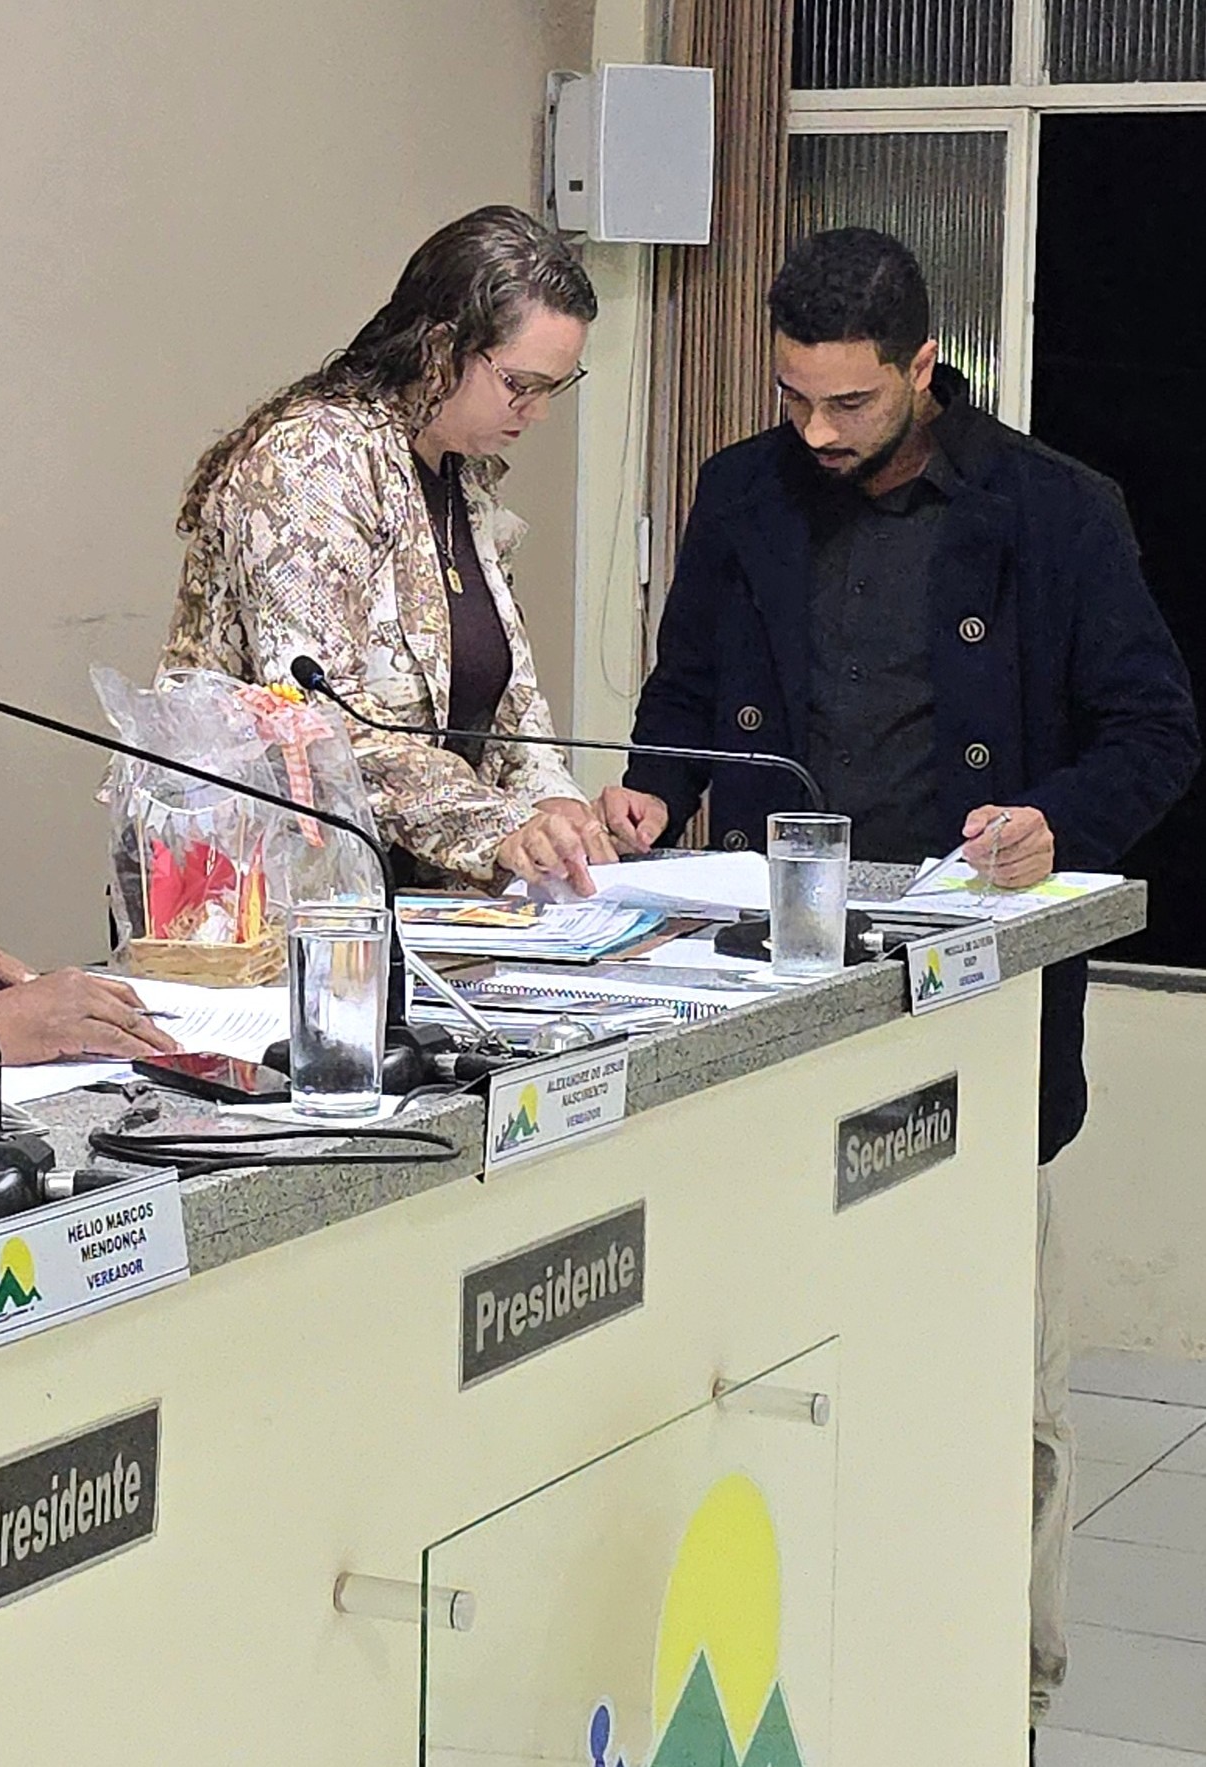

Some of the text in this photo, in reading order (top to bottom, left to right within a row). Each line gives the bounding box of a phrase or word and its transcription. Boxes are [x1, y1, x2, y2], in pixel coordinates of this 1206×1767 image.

[846, 1101, 951, 1183] Secretário
[67, 1202, 153, 1244] HÉLIO MARCOS
[80, 1227, 147, 1262] MENDONÇA
[86, 1258, 144, 1290] VEREADOR
[476, 1241, 636, 1353] Presidente
